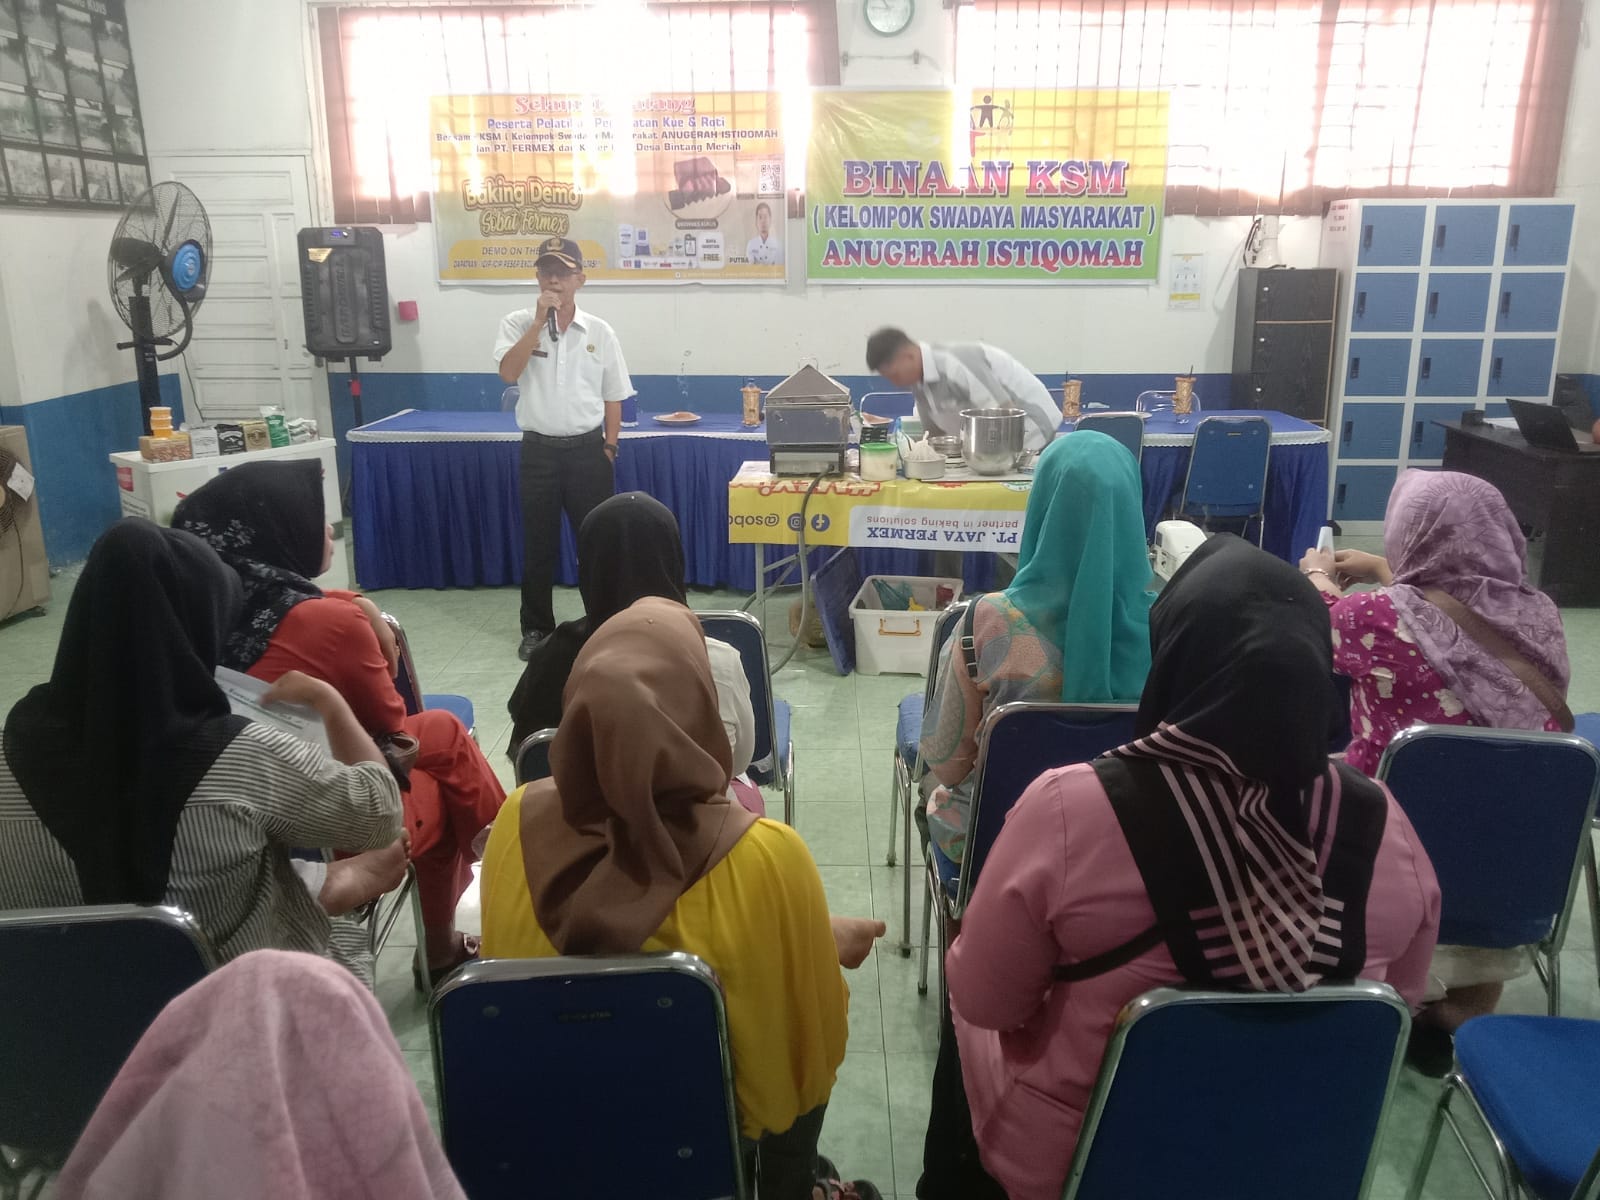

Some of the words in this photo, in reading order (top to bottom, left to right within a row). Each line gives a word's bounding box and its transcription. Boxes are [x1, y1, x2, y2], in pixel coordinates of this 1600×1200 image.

[487, 118, 532, 129] Peserta
[662, 117, 684, 128] Kue
[688, 117, 697, 128] &
[701, 117, 725, 128] Roti
[479, 132, 502, 141] KSM
[511, 131, 555, 142] Kelompok
[661, 130, 718, 139] ANUGERAH
[494, 144, 509, 153] PT.
[512, 143, 555, 152] FERMEX
[636, 143, 660, 152] Desa
[664, 142, 703, 153] Bintang
[706, 141, 741, 151] Meriah
[1025, 160, 1129, 197] KSM
[529, 179, 581, 207] Demo
[481, 209, 520, 234] Sobat
[521, 209, 568, 235] Fermex
[824, 206, 925, 229] KELOMPOK
[929, 206, 1015, 229] SWADAYA
[1019, 206, 1145, 230] MASYARAKAT
[482, 246, 508, 256] DEMO
[509, 246, 523, 256] ON
[822, 239, 980, 267] ANUGERAH
[986, 239, 1145, 272] ISTIQOMAH
[729, 256, 749, 264] PUTRA
[866, 515, 917, 526] solutions
[921, 516, 959, 528] baking
[963, 520, 974, 528] in
[976, 519, 1019, 529] partner
[866, 526, 938, 542] FERMEX
[944, 530, 986, 543] JAYA
[991, 531, 1018, 544] PT.
